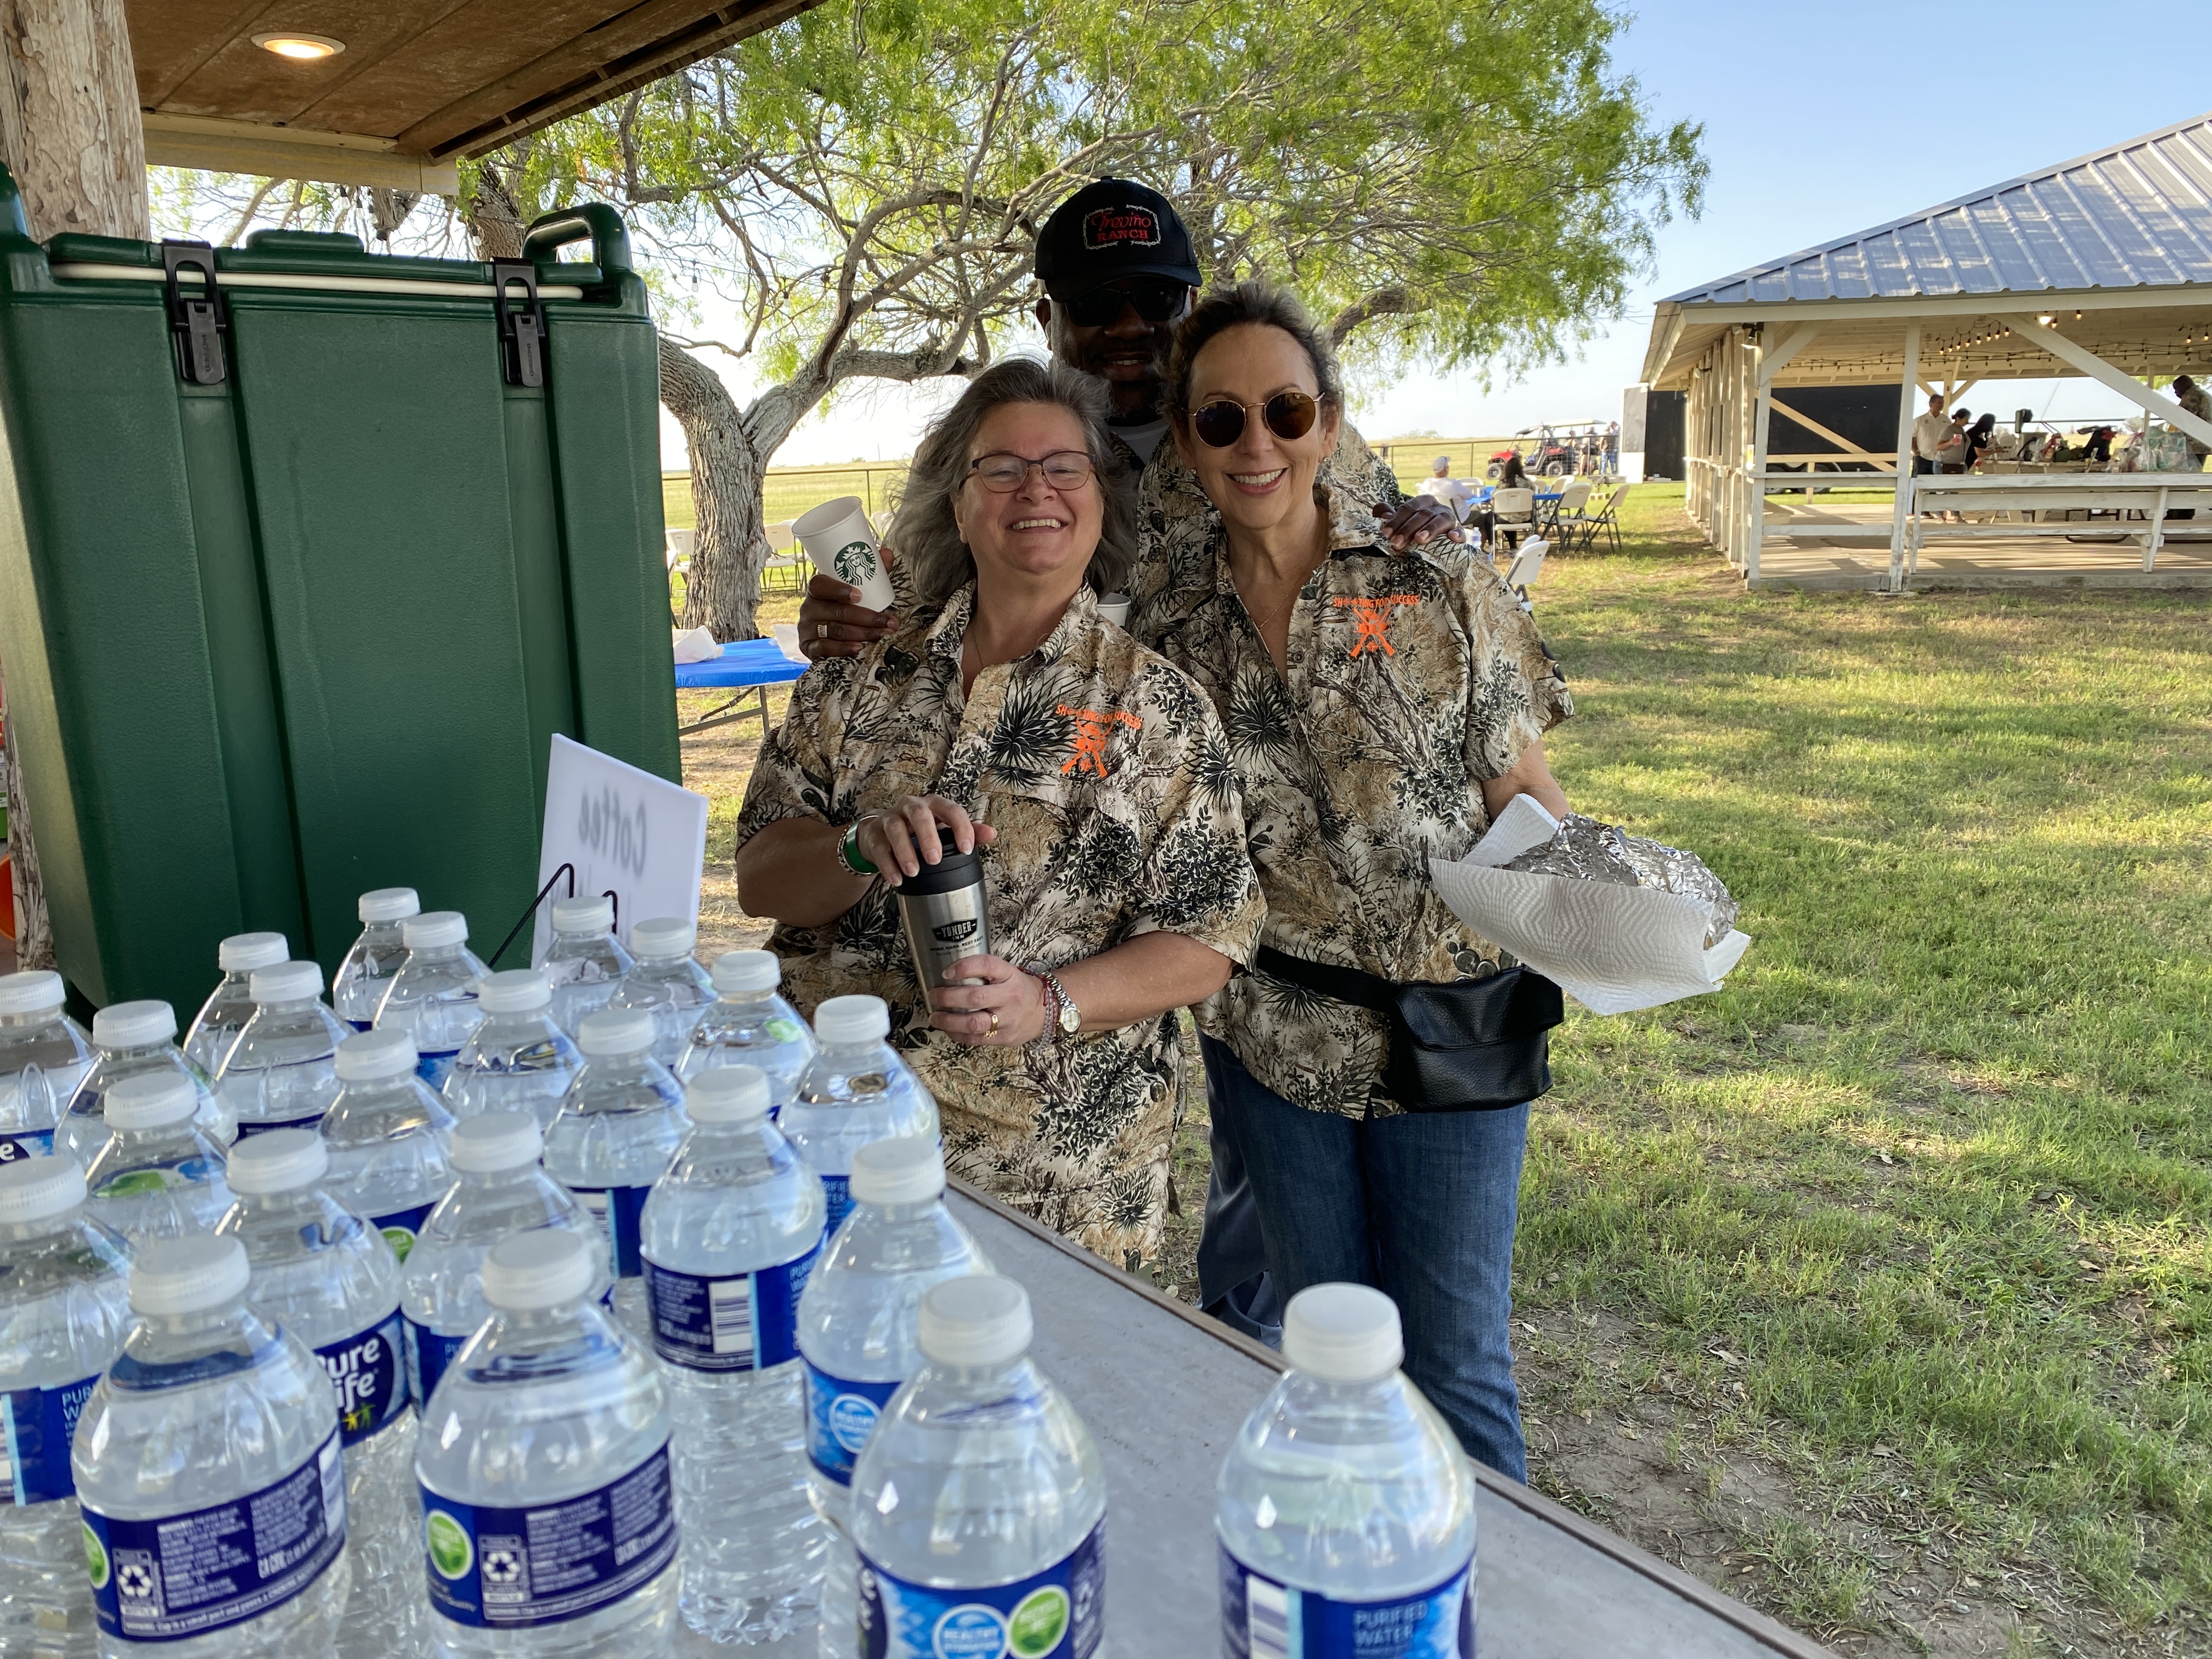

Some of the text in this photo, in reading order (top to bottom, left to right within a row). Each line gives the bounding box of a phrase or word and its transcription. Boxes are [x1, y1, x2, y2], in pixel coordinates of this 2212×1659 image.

[1097, 229, 1149, 242] RANCH
[1390, 594, 1420, 605] SUCCESS
[941, 921, 972, 938] YONDER
[334, 1372, 376, 1414] ife
